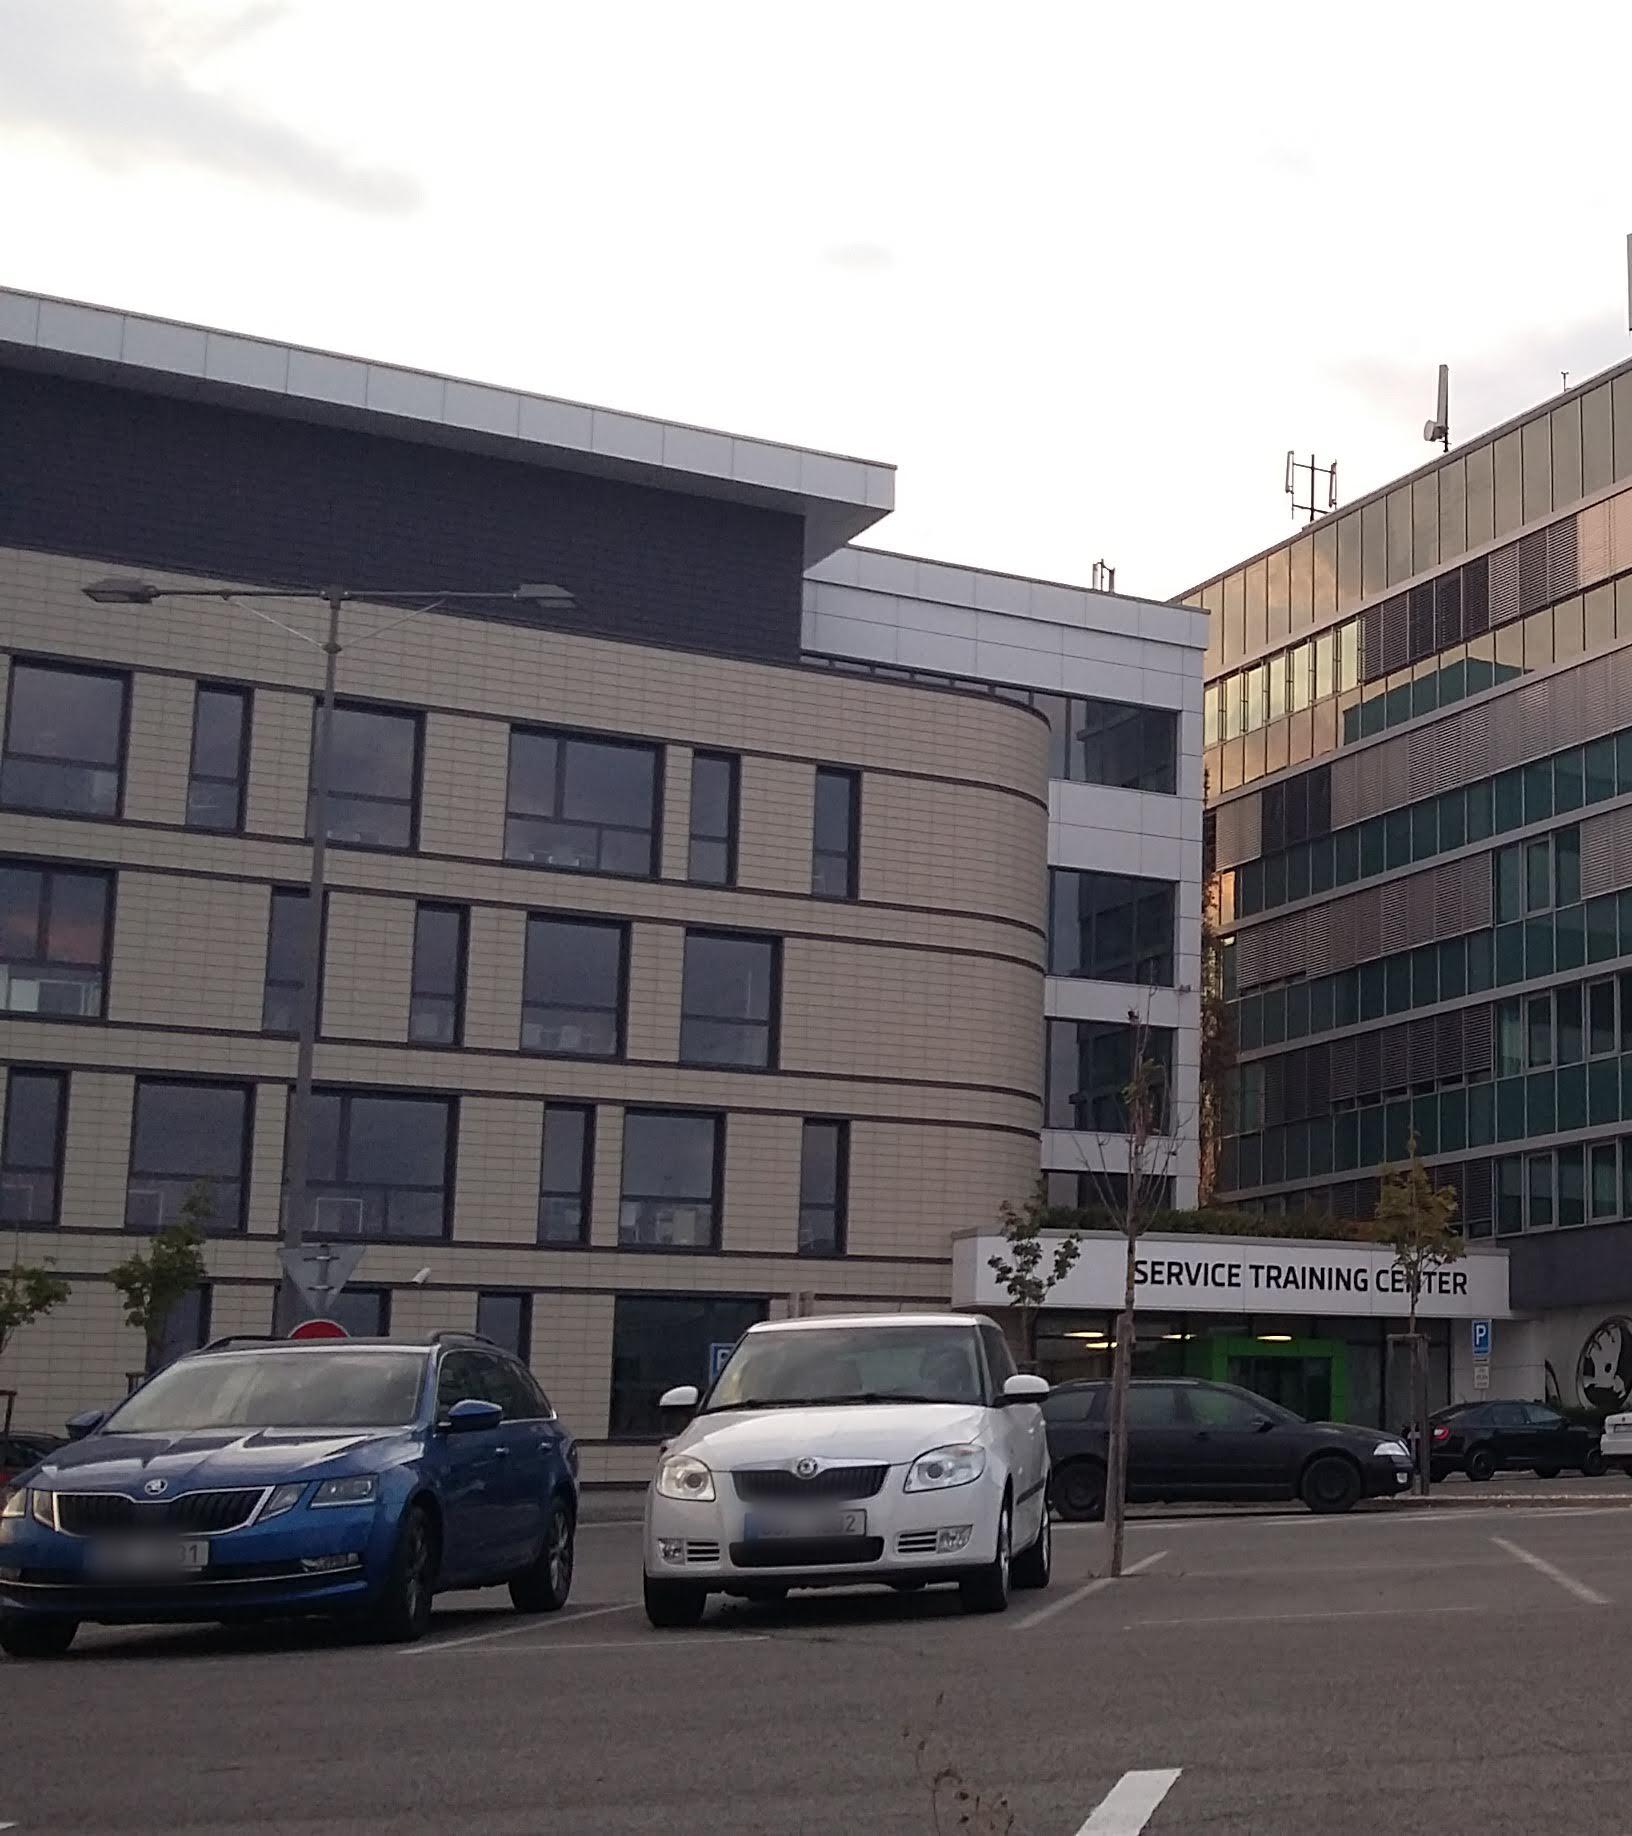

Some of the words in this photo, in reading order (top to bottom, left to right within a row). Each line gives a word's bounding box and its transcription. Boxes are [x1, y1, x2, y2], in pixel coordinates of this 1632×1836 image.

[1134, 1260, 1241, 1287] SERVICE
[1249, 1264, 1369, 1292] TRAINING
[1476, 1325, 1487, 1346] P
